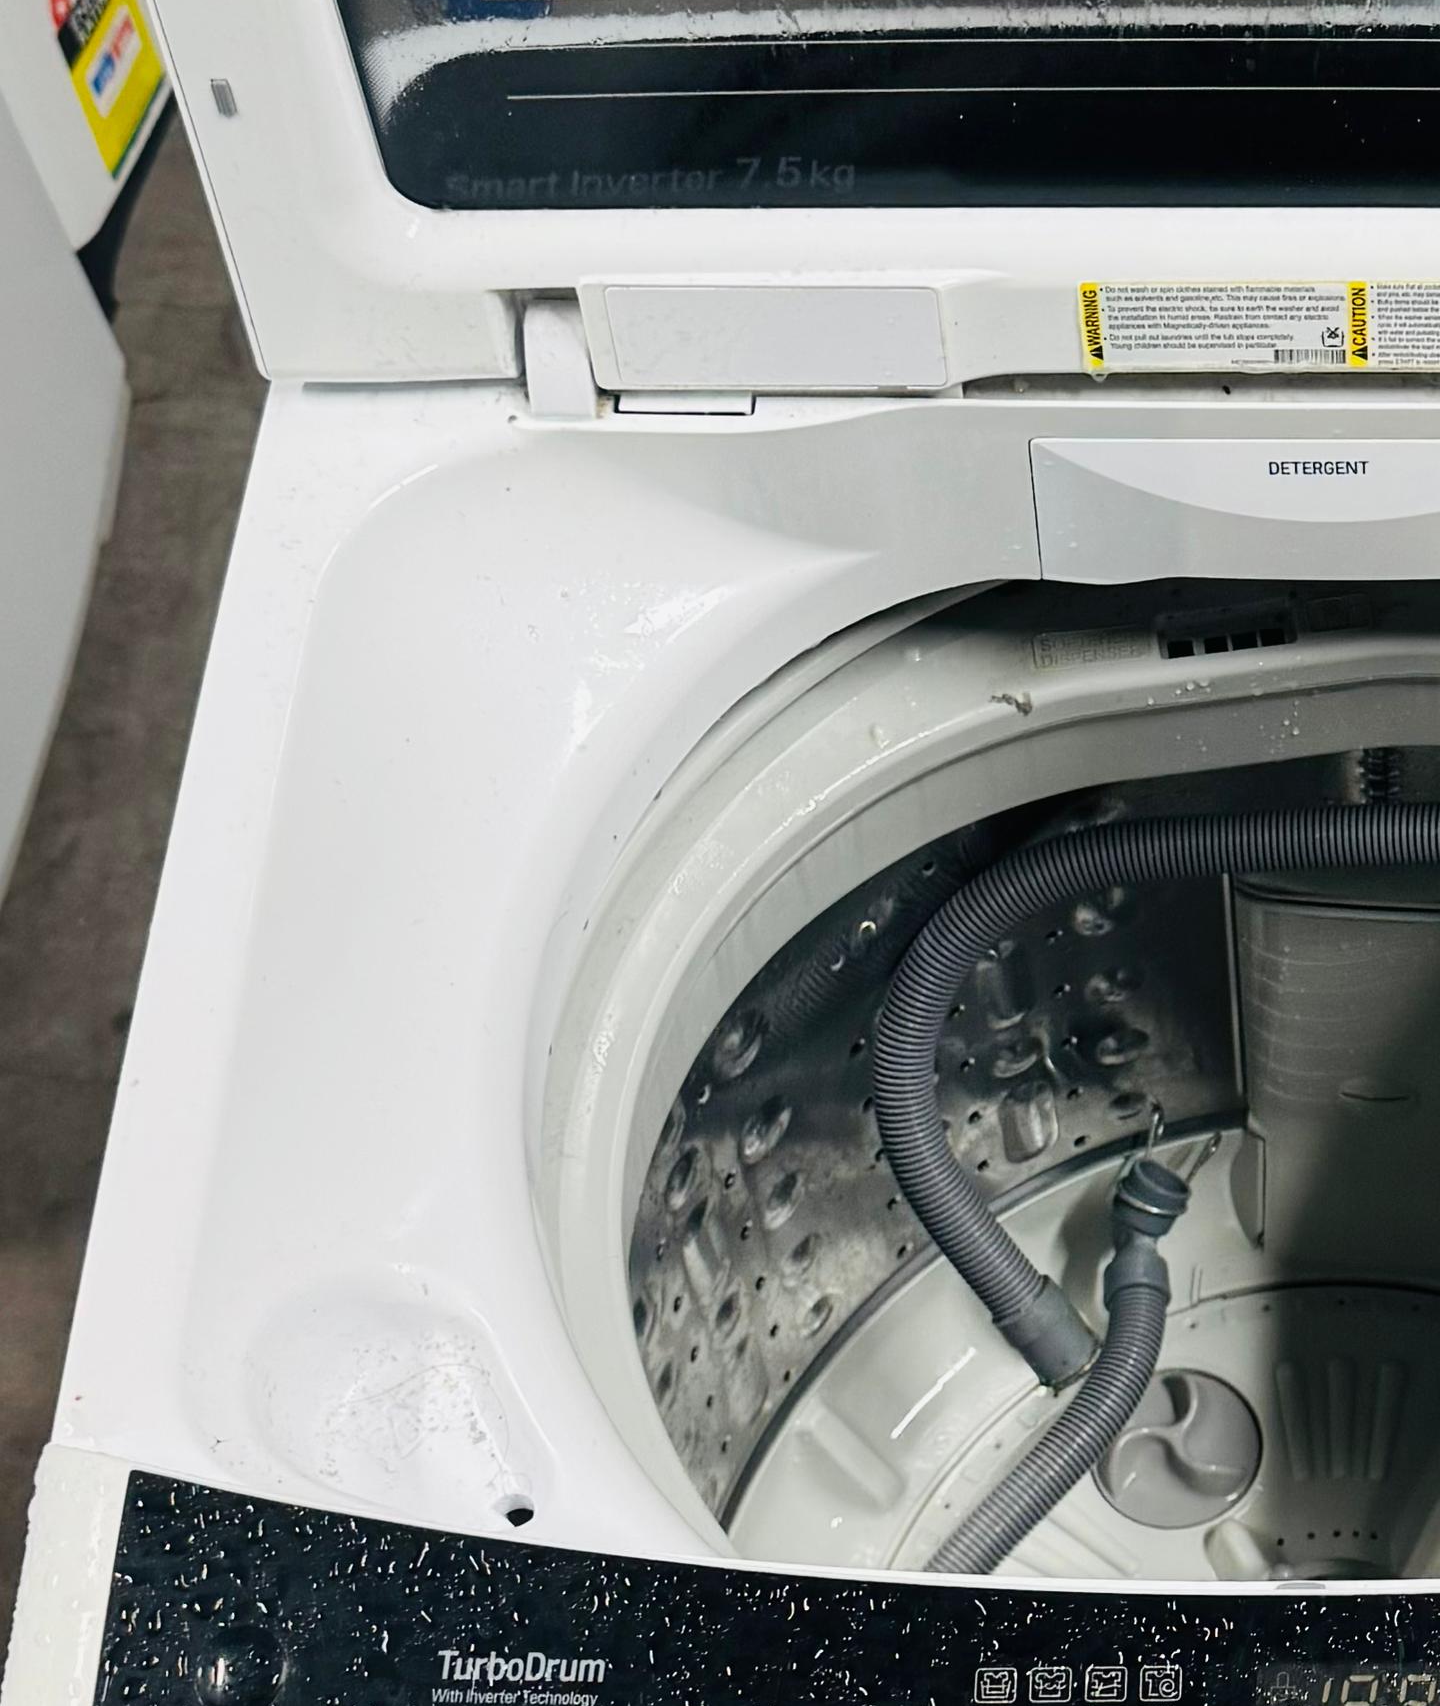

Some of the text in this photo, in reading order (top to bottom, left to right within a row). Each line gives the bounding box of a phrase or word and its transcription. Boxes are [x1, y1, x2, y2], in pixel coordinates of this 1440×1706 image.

[446, 172, 557, 199] Smart
[572, 168, 723, 196] Inverter
[1083, 290, 1100, 346] WARNING
[1352, 288, 1366, 346] CAUTION
[1269, 460, 1370, 475] DETERGENT
[438, 1650, 606, 1683] TurboDrum
[432, 1688, 464, 1704] With
[466, 1689, 518, 1704] Inverter
